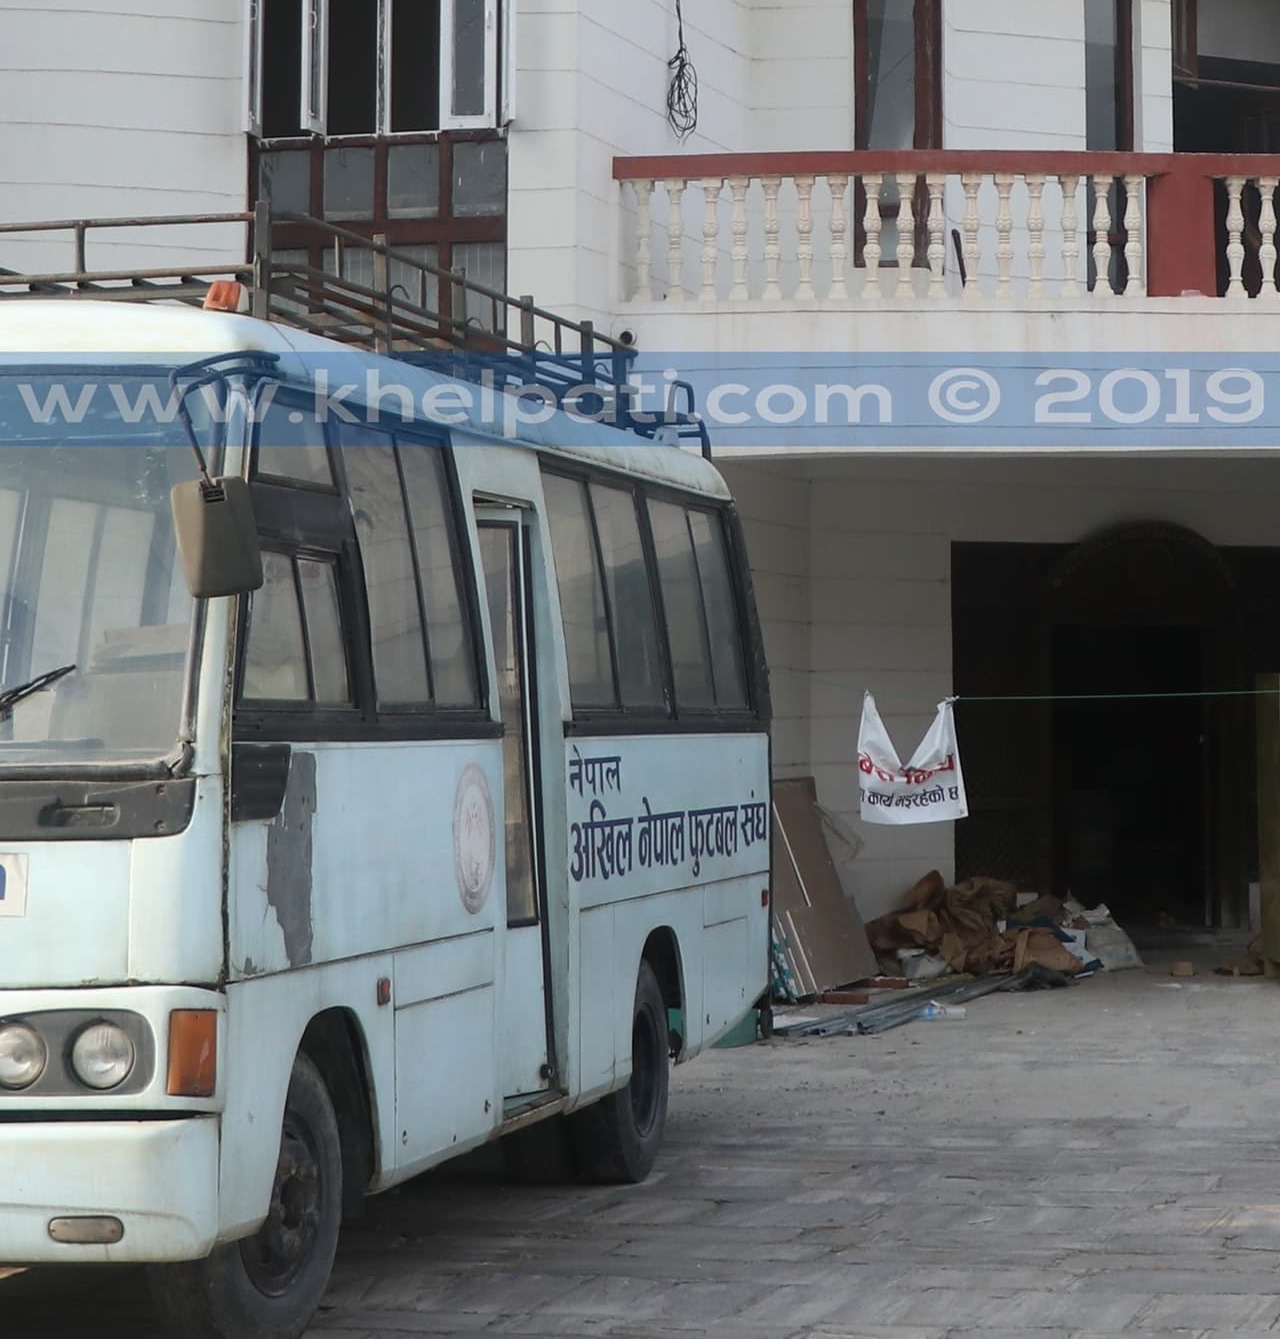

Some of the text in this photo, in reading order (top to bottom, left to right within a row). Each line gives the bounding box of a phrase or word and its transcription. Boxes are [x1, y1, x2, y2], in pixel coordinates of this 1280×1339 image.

[569, 745, 622, 797] नेपाल
[570, 799, 634, 882] अखिल
[638, 796, 685, 868] नेपाल
[688, 805, 739, 877] फुटबल
[740, 790, 767, 846] संघ
